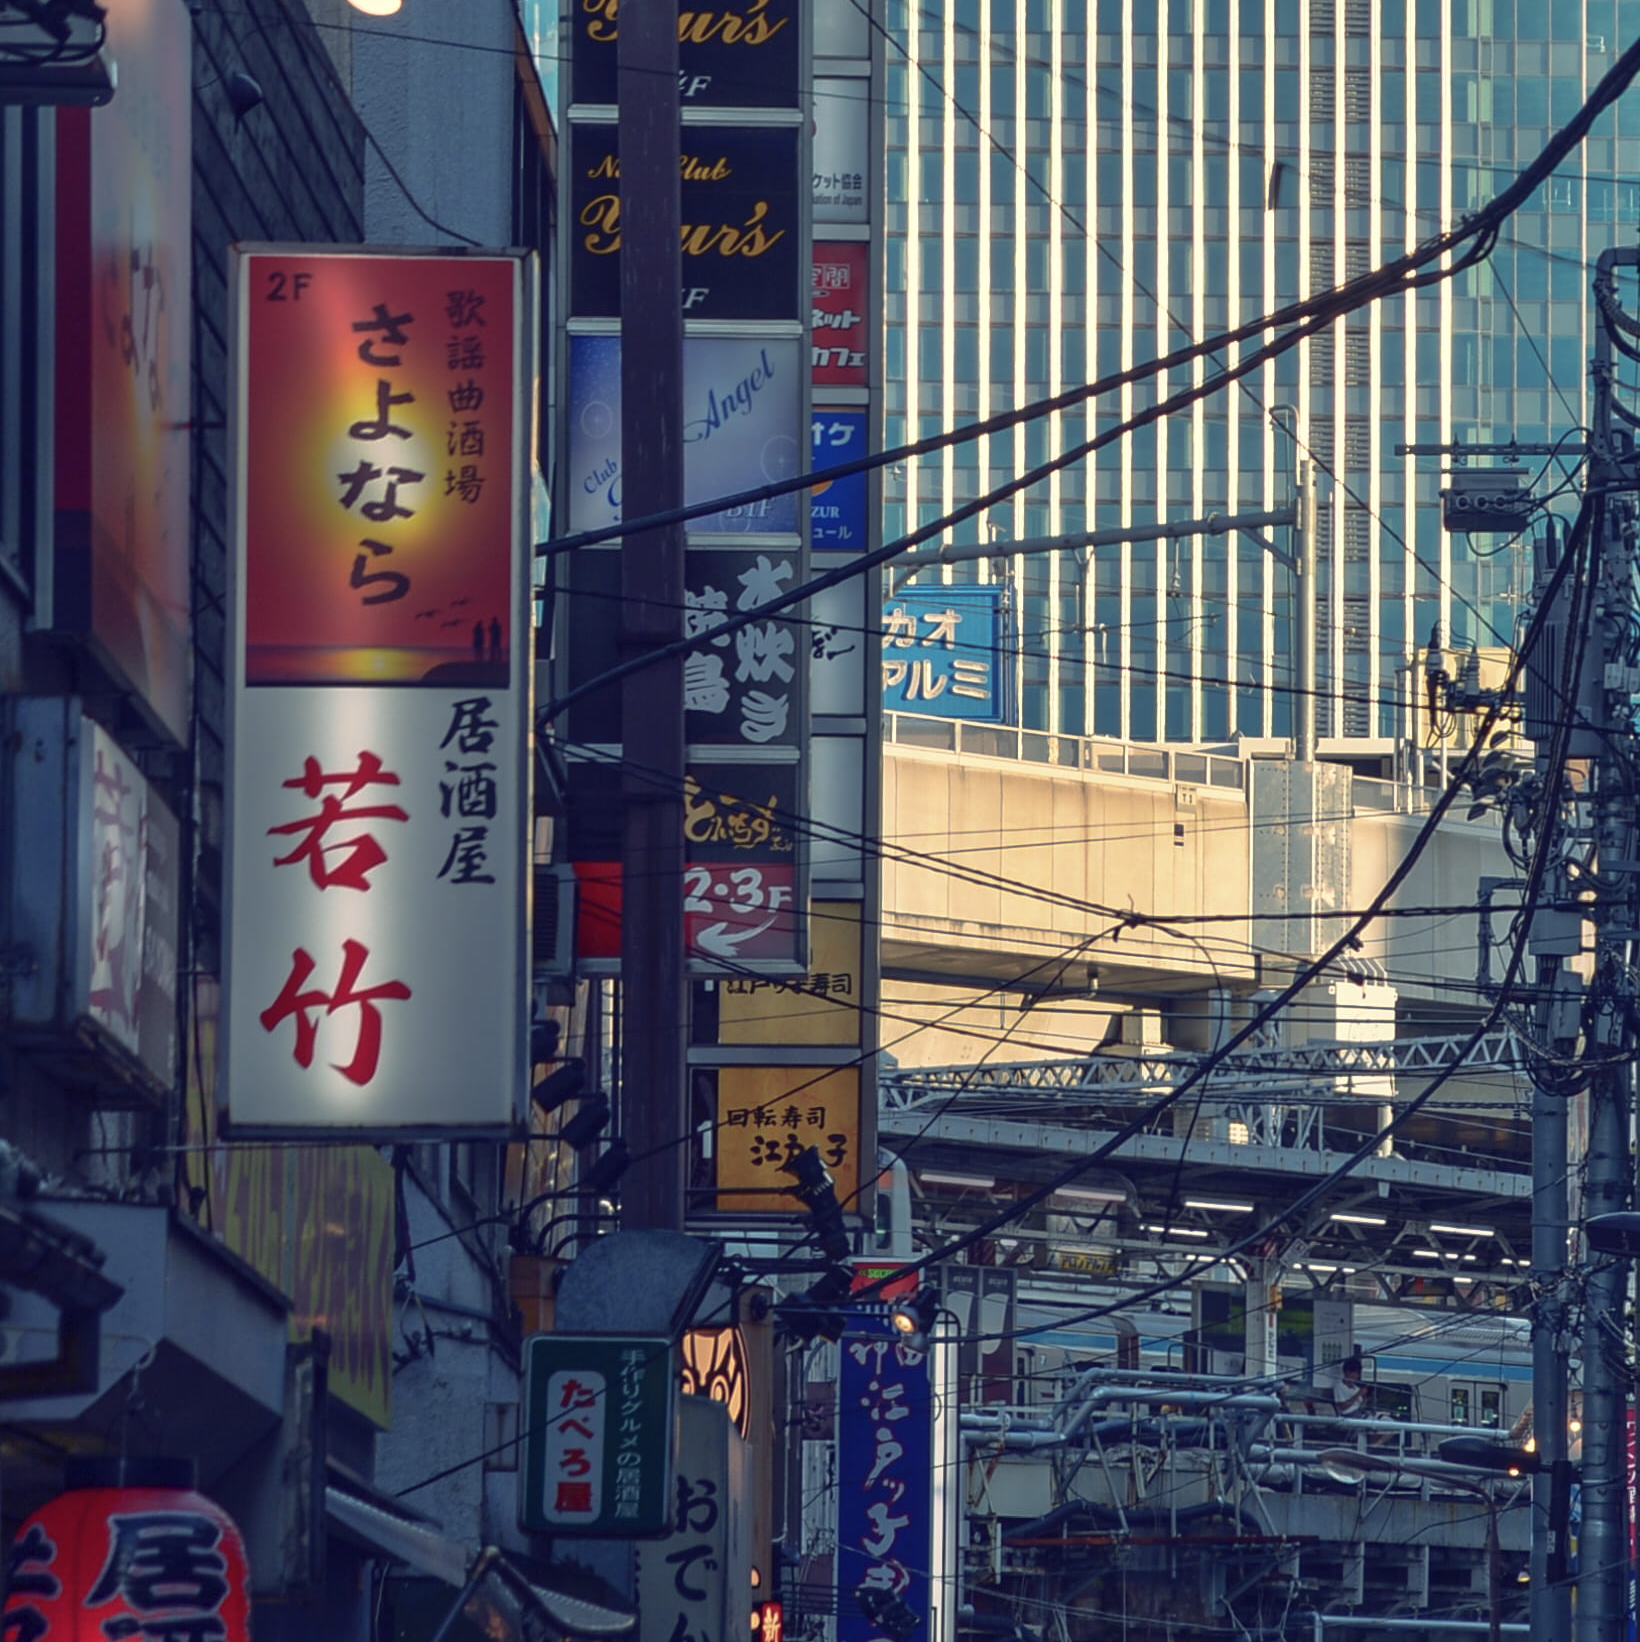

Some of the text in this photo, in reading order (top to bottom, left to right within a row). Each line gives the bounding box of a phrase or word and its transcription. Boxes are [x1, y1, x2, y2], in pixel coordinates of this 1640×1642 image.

[266, 272, 313, 301] 2F
[580, 195, 786, 256] Yur's
[337, 303, 425, 606] さよなら
[443, 290, 487, 504] 歌謡曲酒場
[683, 349, 775, 443] Angel
[735, 554, 795, 743] 水炊き
[437, 697, 499, 885] 居酒屋
[260, 750, 412, 1086] 若竹
[727, 1105, 826, 1130] 回転寿司
[750, 1133, 848, 1171] 江戸子
[615, 1349, 647, 1518] 手作りグルメの居酒屋
